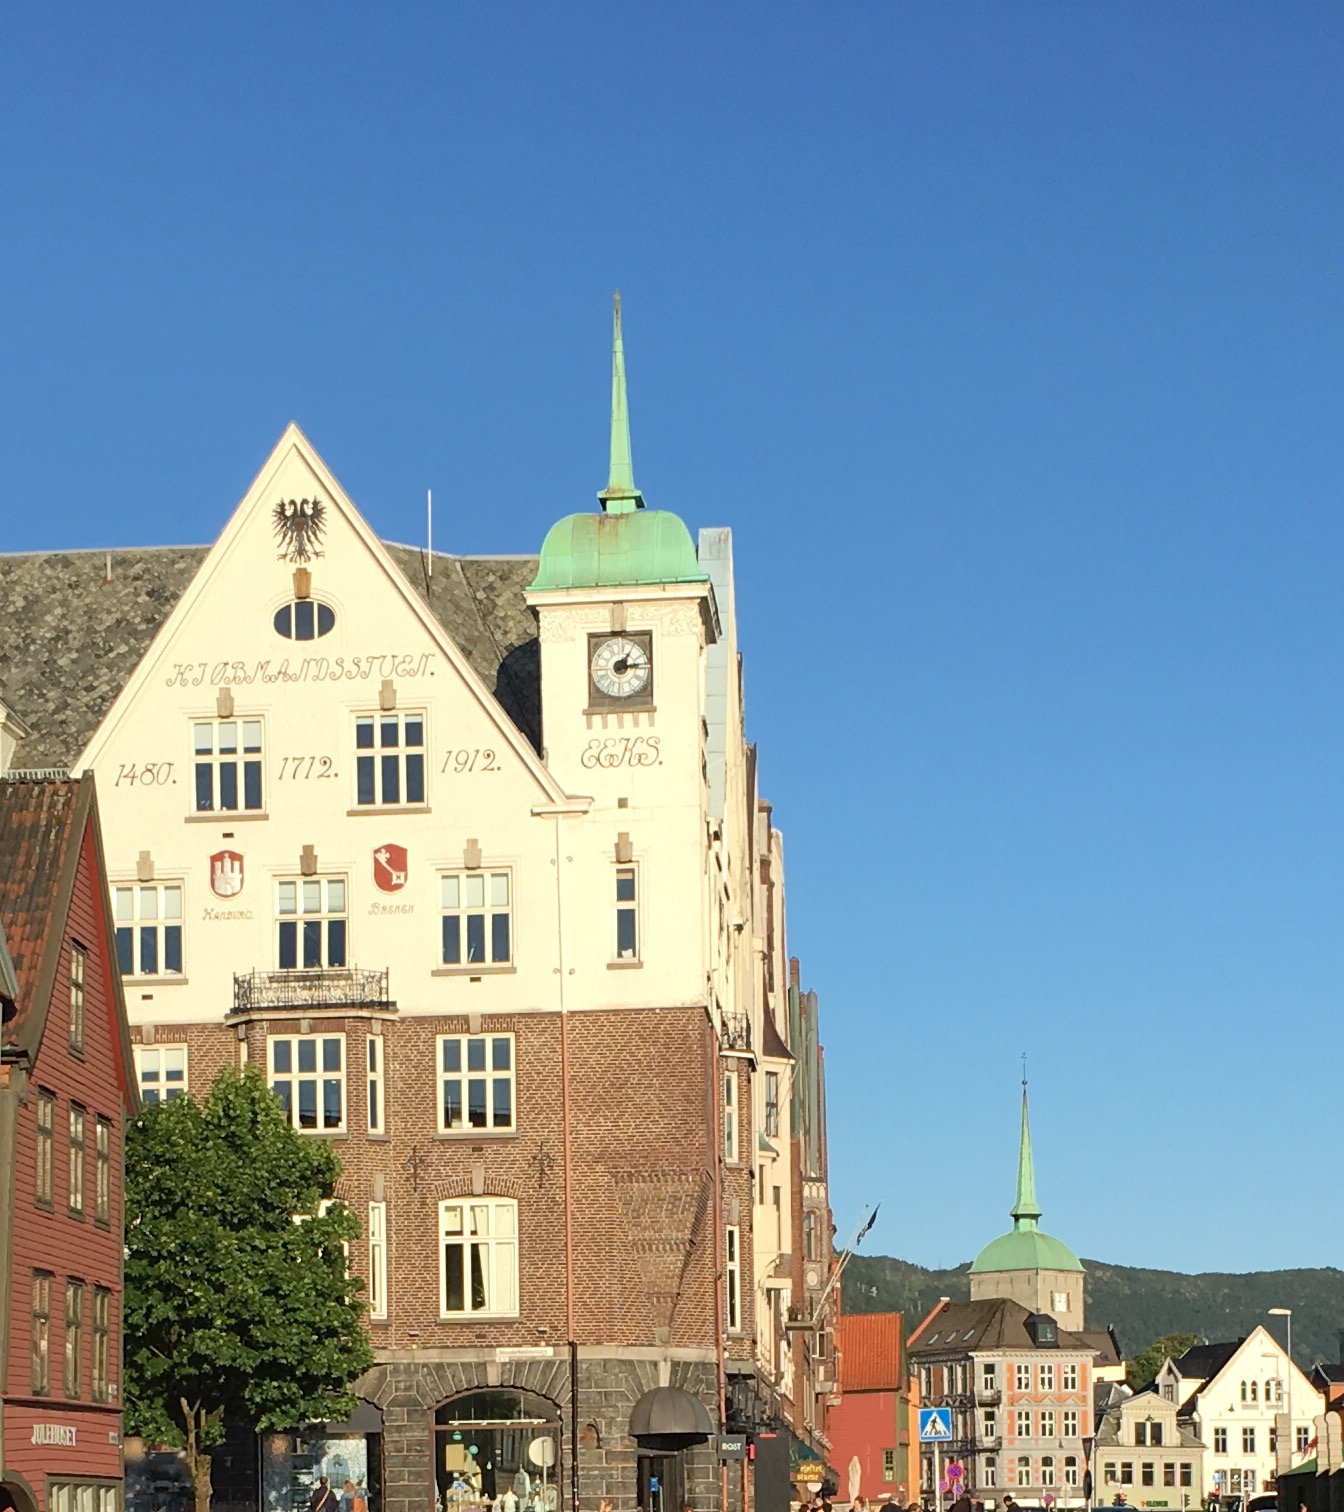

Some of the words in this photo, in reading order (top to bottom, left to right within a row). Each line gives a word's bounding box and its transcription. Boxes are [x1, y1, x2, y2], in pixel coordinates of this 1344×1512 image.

[277, 755, 339, 781] 1712.
[440, 748, 502, 775] 1912.
[114, 762, 178, 788] 1480.
